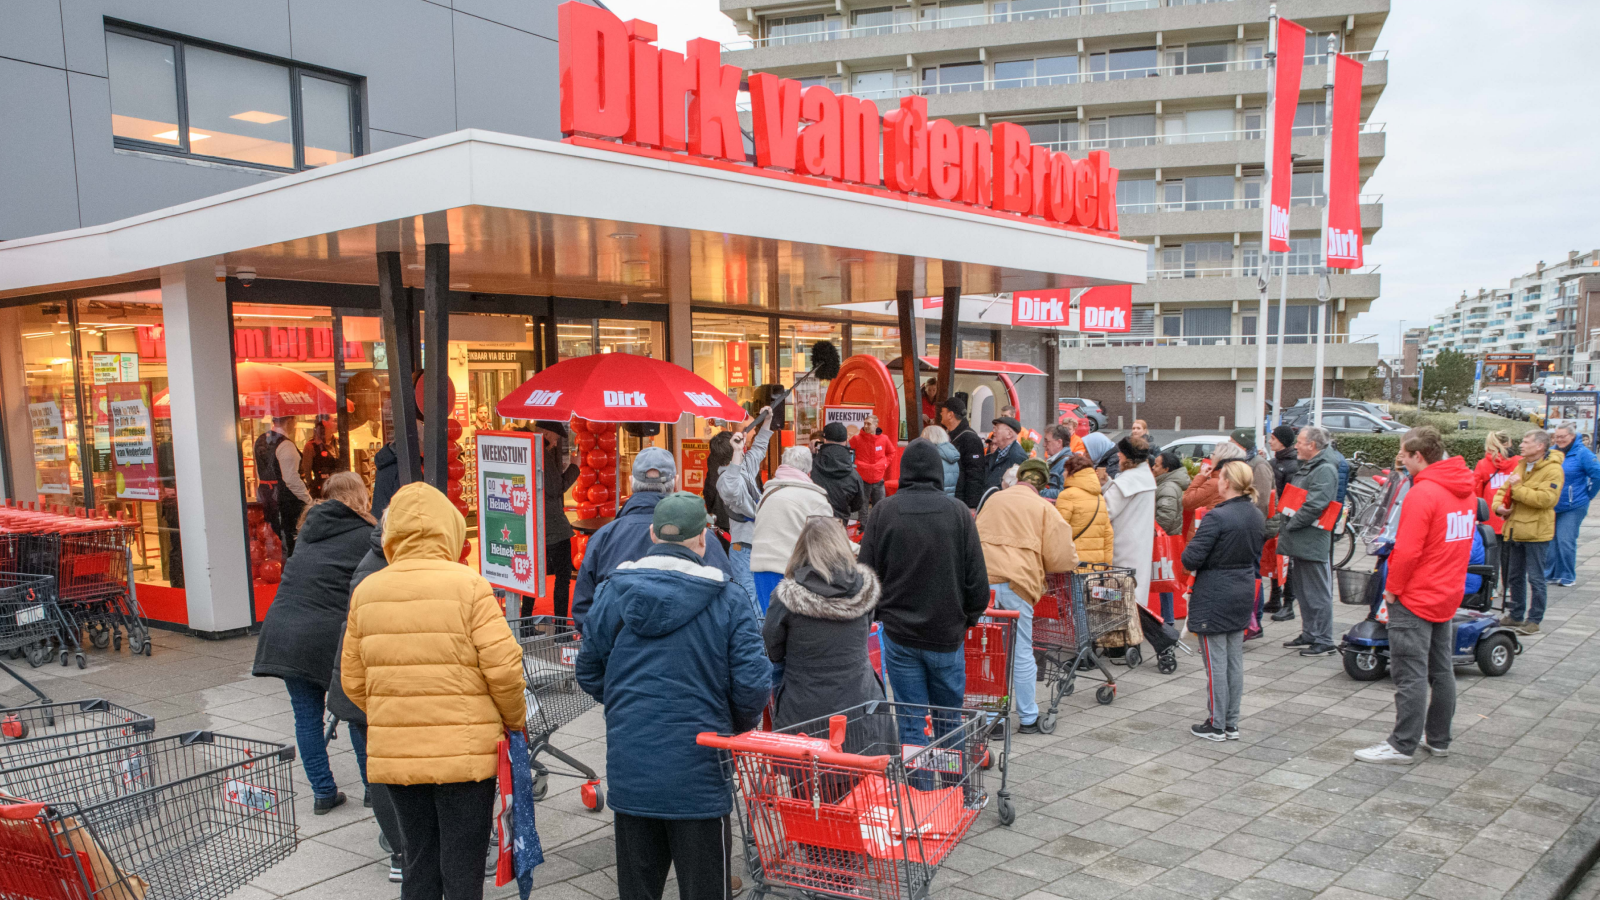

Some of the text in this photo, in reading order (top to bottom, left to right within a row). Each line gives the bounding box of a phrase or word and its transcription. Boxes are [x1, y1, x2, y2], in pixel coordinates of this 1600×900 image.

[558, 1, 1119, 231] Dirk van den Broek
[1328, 227, 1358, 257] Dirk
[1018, 297, 1063, 321] Dirk
[1085, 307, 1126, 328] Dirk
[271, 326, 307, 361] bij
[312, 327, 365, 358] Dik
[467, 352, 516, 360] EIKBAAR VIA DE LIFT
[280, 392, 313, 404] Dirk
[524, 389, 563, 406] Dirk
[603, 390, 648, 407] Dirk
[684, 392, 722, 407] Dirk
[127, 405, 140, 415] 2024
[828, 411, 870, 421] WEEKSTUNT
[116, 447, 152, 458] van Nederland!
[482, 444, 527, 464] WEEKSTUNT
[1490, 472, 1513, 488] Dir
[489, 498, 514, 511] Heinek
[513, 490, 527, 507] 12.99
[1446, 510, 1475, 540] Dirk
[491, 543, 515, 557] Heinek
[515, 557, 529, 574] 13.99
[1151, 557, 1175, 580] rk
